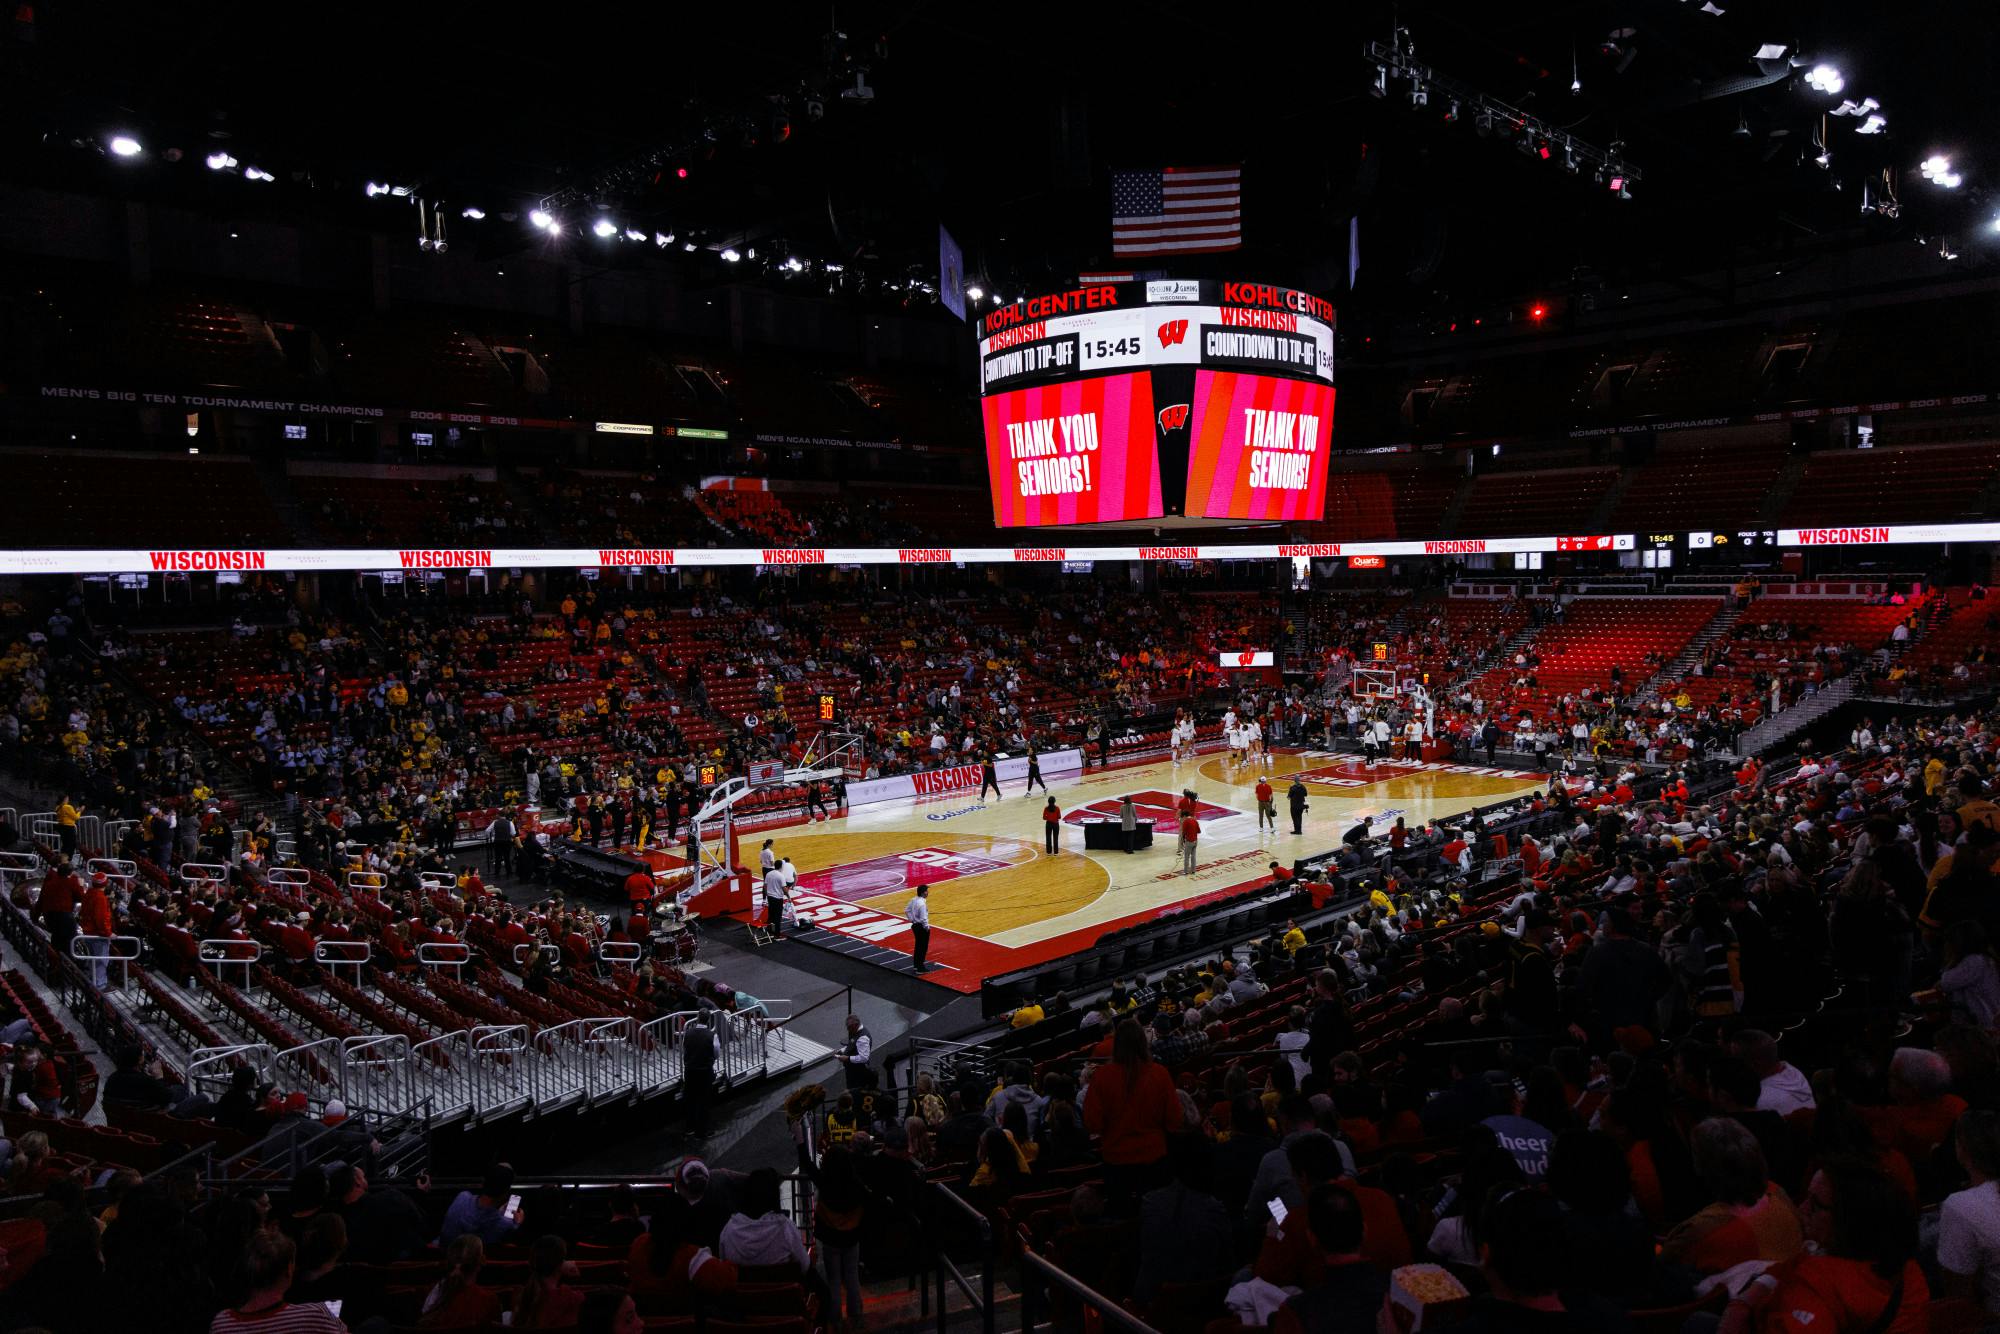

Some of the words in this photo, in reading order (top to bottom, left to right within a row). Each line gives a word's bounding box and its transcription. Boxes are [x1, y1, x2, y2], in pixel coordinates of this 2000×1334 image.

[986, 303, 1024, 333] KOHL
[1028, 286, 1118, 319] CENTER
[1224, 282, 1283, 307] KOHL
[1287, 291, 1333, 321] CENTER
[1220, 307, 1297, 333] WISCONSIN
[989, 321, 1047, 353] WISCONSIN
[1084, 338, 1141, 359] 15:45
[1207, 332, 1276, 359] COUNTDOWN
[1277, 337, 1289, 361] TO
[1290, 341, 1315, 366] TIP-OFF
[985, 351, 1023, 383] COUNTDOWN
[1024, 347, 1036, 371] TO
[1037, 341, 1074, 369] TIP-OFF
[41, 386, 101, 399] MEN'S
[106, 391, 136, 402] BIG
[142, 393, 177, 404] TEN
[183, 396, 294, 411] TOURNAMENT
[300, 404, 384, 416] CHAMPIONS
[410, 410, 443, 421] 2004
[1007, 418, 1057, 459] THANK
[1059, 412, 1099, 452] YOU
[1245, 408, 1297, 450] THANK
[1298, 415, 1319, 452] YOU
[1569, 427, 1616, 438] WOMEN'S
[1619, 424, 1648, 433] NCAA
[1652, 416, 1730, 432] TOURNAMENT
[756, 434, 784, 443] MEN'S
[786, 436, 811, 445] NCAA
[812, 438, 852, 447] NATIONAL
[856, 440, 901, 450] CHAMPIONS
[1346, 446, 1398, 455] CHAMPIONS
[1018, 455, 1092, 497] SENIORS!
[1249, 451, 1311, 490] SENIORS!
[1649, 535, 1675, 543] 15:45
[1697, 536, 1704, 544] 0
[1798, 528, 1890, 545] WISCONSIN
[1014, 548, 1066, 560] WISCONSIN
[1139, 547, 1199, 560] WISCONSIN
[1278, 544, 1341, 557] WISCONSIN
[1425, 540, 1486, 553] WISCONSIN
[150, 551, 265, 570] WISCONSIN
[400, 550, 491, 568] WISCONSIN
[599, 550, 674, 565] WISCONSIN
[763, 549, 825, 563] WISCONSIN
[899, 549, 952, 562] WISCONSIN
[1354, 557, 1380, 566] Quartz
[1375, 650, 1386, 659] 30
[821, 704, 833, 718] 30
[702, 774, 713, 783] 30
[1497, 1131, 1549, 1153] heer
